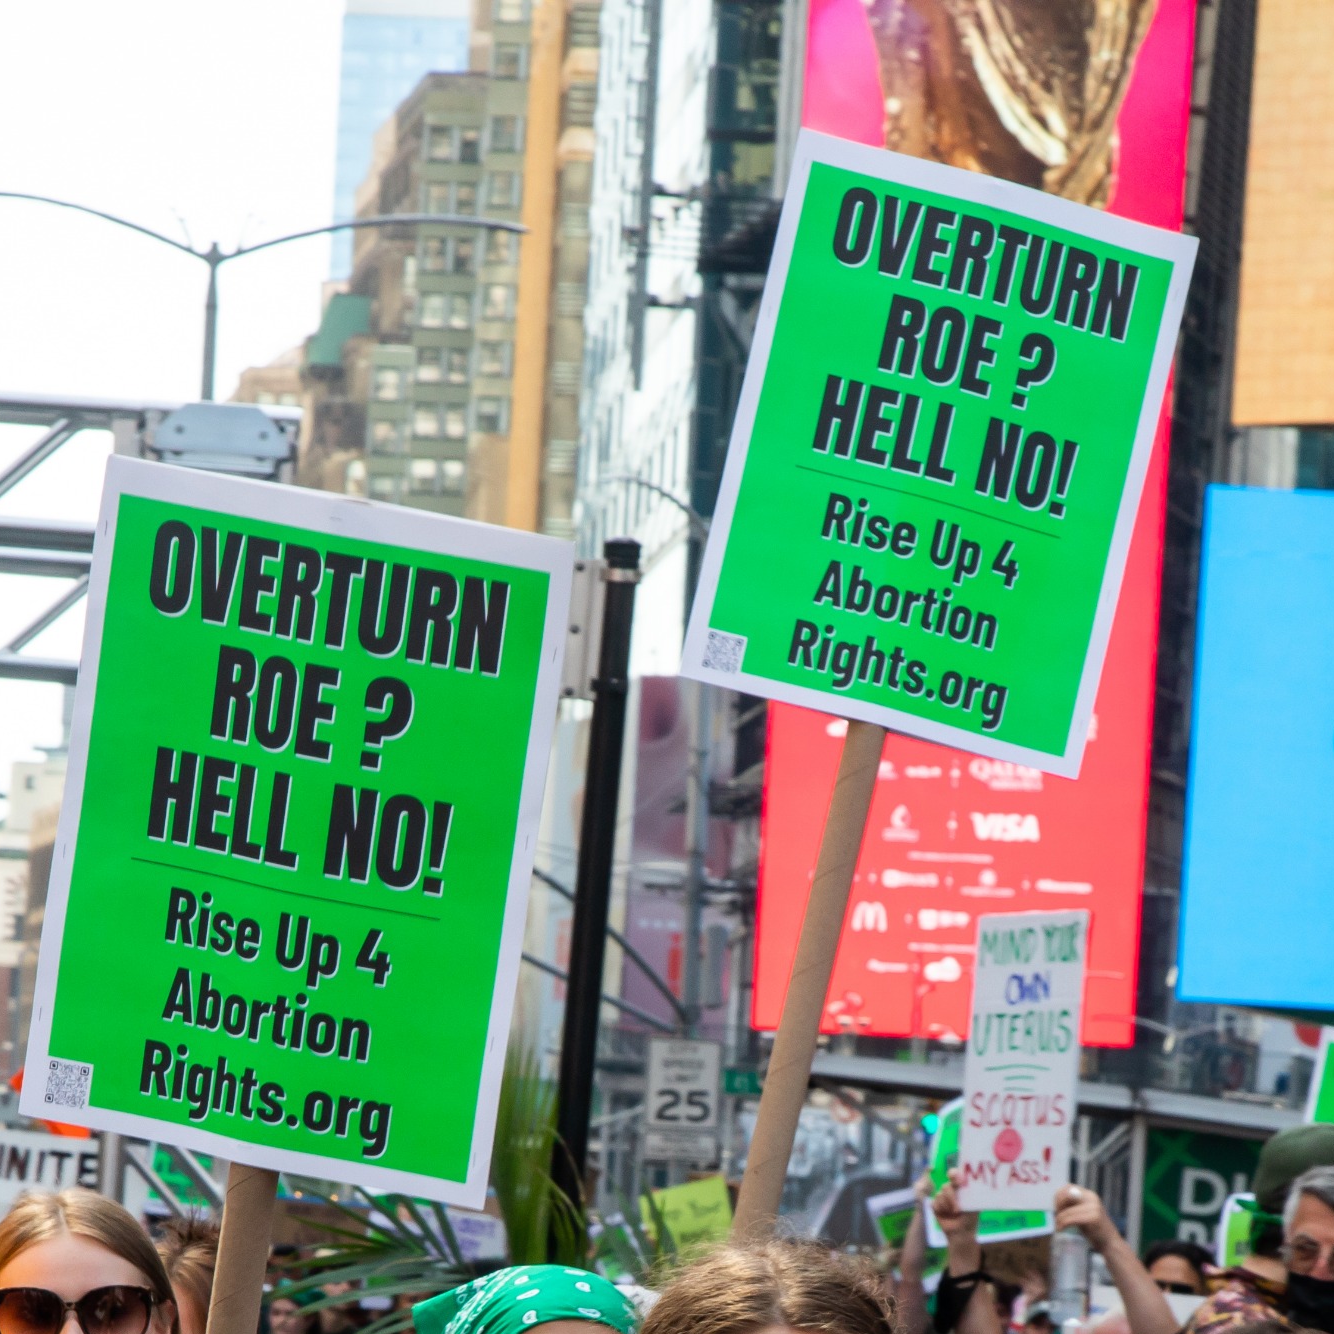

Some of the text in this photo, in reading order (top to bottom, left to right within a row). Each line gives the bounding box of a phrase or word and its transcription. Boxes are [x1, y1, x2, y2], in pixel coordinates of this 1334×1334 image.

[832, 186, 1141, 344] OVERTURN
[877, 293, 1005, 398] ROE
[812, 373, 1080, 519] HELL NO!
[821, 492, 1020, 590] Rise Up 4
[148, 519, 511, 677] OVERTURN
[813, 560, 998, 651] Abortion
[209, 644, 342, 764] ROE
[787, 618, 1009, 732] Rights.org
[146, 746, 456, 898] HELL NO!
[970, 811, 1041, 843] VISA
[165, 886, 392, 989] Rise Up 4
[162, 966, 372, 1062] Abortion
[972, 1009, 1072, 1056] UTERUS
[1005, 972, 1051, 1007] OWN
[138, 1039, 393, 1159] Rights.org
[655, 1088, 711, 1123] 25
[970, 1091, 1066, 1128] SCOTUS
